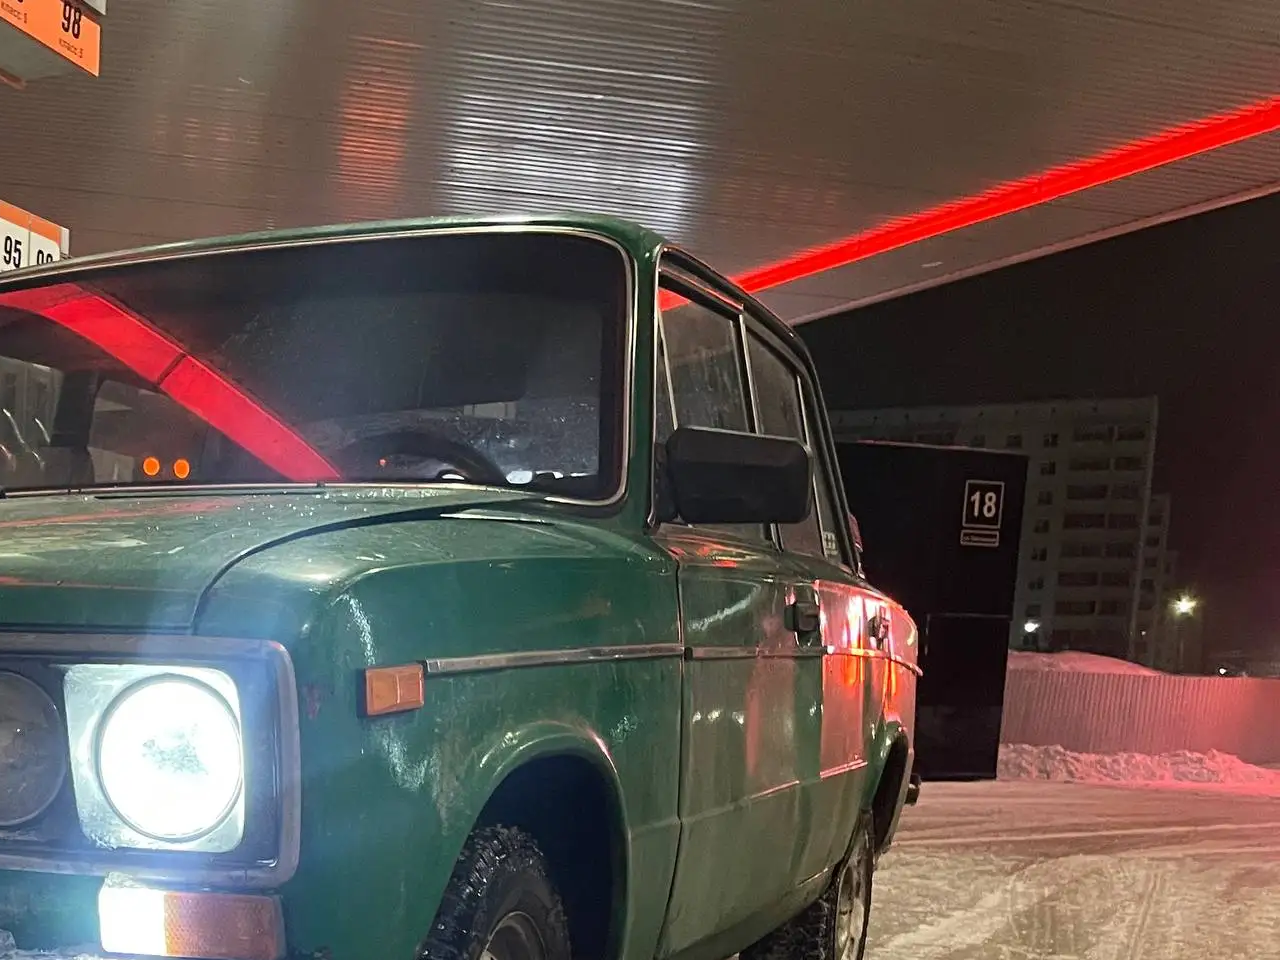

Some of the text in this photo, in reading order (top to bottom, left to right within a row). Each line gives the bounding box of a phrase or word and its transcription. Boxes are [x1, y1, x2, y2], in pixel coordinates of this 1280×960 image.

[62, 0, 81, 39] 98
[3, 235, 22, 268] 95
[970, 490, 997, 518] 18
